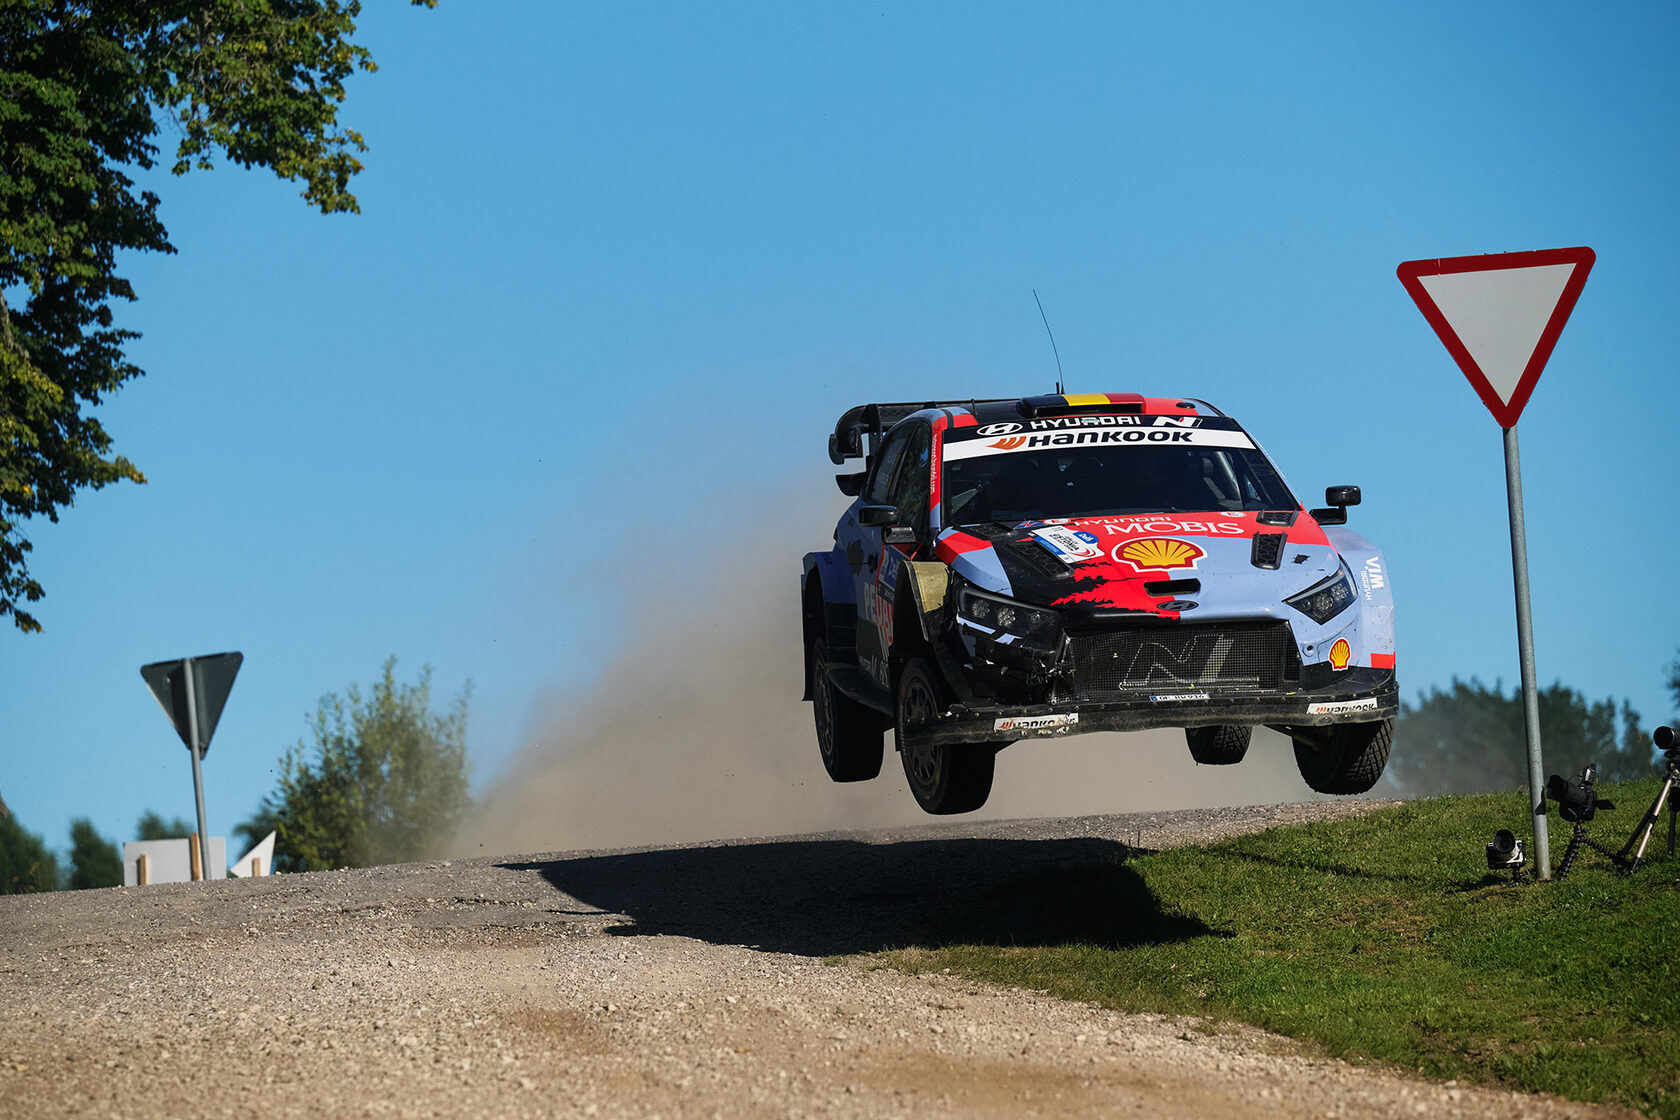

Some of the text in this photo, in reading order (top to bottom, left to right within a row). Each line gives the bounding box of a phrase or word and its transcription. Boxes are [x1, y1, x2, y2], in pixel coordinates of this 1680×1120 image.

[1028, 430, 1194, 448] Hankook
[1073, 516, 1172, 527] HYUNDAI
[1102, 521, 1245, 535] MOBIS
